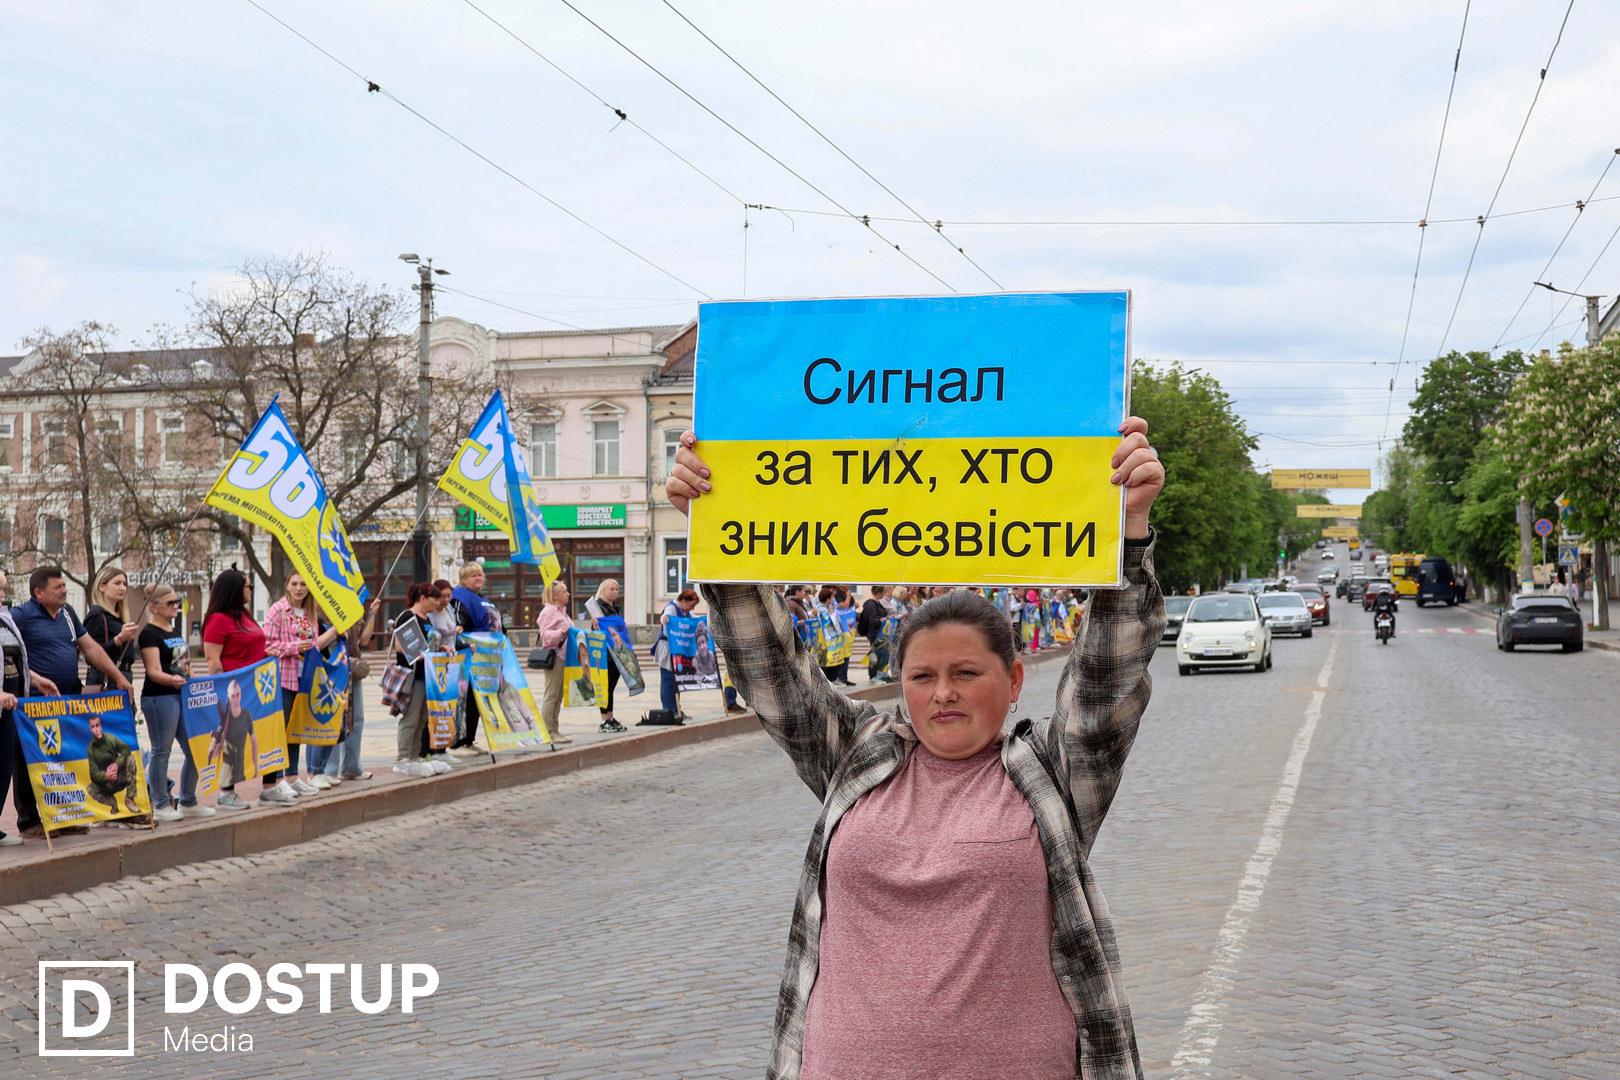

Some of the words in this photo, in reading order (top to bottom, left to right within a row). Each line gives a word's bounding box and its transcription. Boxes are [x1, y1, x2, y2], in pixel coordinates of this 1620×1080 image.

[803, 357, 1005, 405] Сигнал
[227, 413, 326, 519] 56
[755, 450, 812, 485] за
[832, 449, 938, 493] тих,
[960, 447, 1053, 484] хто
[719, 519, 838, 556] зник
[857, 508, 1096, 558] безвісти
[240, 500, 289, 534] МОТОПІХОТНА
[286, 533, 325, 592] МАРІУПОЛЬСЬКА
[322, 589, 348, 622] БРИГАДА
[24, 700, 66, 718] ЧЕКАЄМО
[67, 698, 89, 715] ТЕБЕ
[87, 695, 124, 714] ВДОМА!
[188, 692, 218, 709] УКРАЇНІ
[190, 680, 214, 695] СЛАВА
